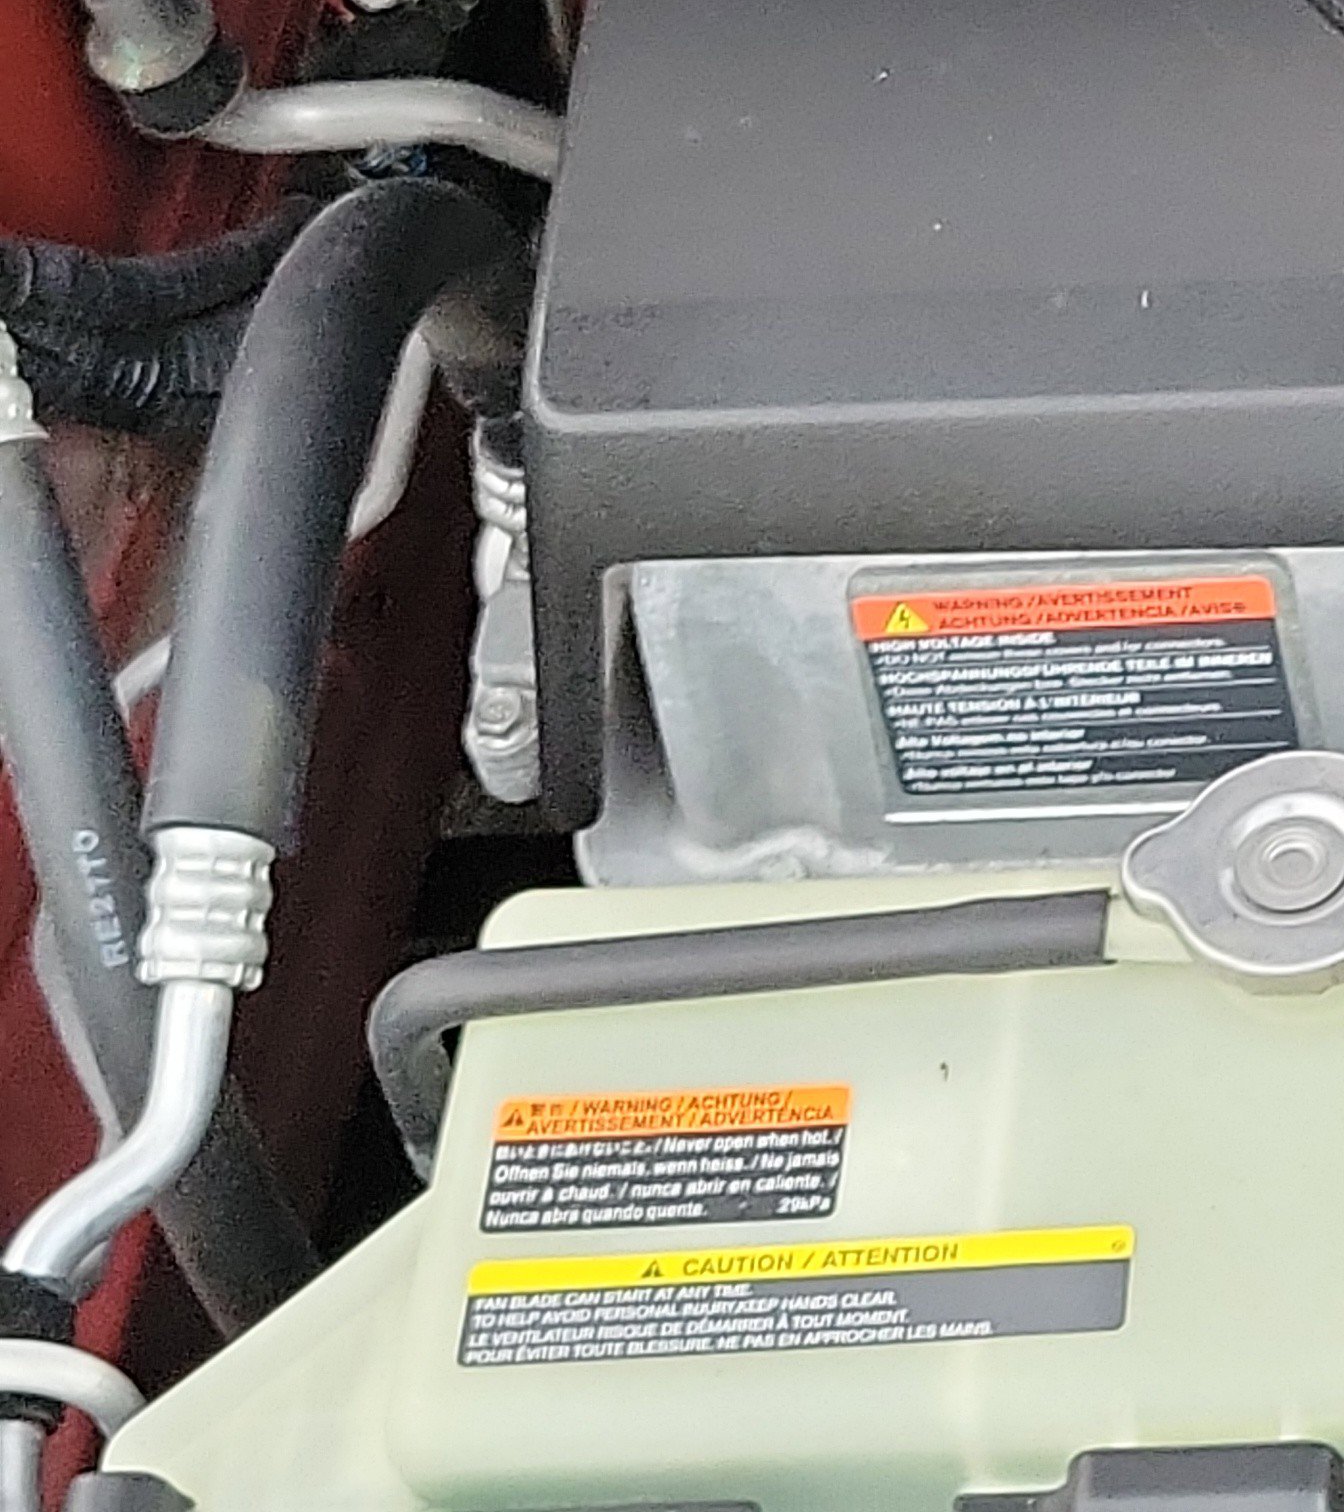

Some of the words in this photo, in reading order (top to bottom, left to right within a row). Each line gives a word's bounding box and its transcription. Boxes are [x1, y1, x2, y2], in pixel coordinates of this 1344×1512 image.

[934, 595, 1022, 611] WARNING
[939, 614, 1031, 629] ACHTUNG
[583, 1097, 672, 1115] WARNING
[688, 1091, 781, 1110] ACHTUNG
[526, 1114, 685, 1136] AVERTISSEMENT
[700, 1105, 834, 1127] ADVERTENCIA
[663, 1135, 712, 1153] Never
[713, 1134, 755, 1153] open
[757, 1131, 800, 1149] when
[552, 1162, 580, 1181] Sie
[653, 1159, 698, 1176] wenn
[785, 1150, 840, 1175] jamais
[489, 1189, 540, 1206] ouvrir
[630, 1180, 682, 1197] nunca
[684, 1176, 728, 1197] abrir
[728, 1179, 751, 1195] en
[485, 1209, 540, 1228] Nunca
[541, 1207, 580, 1226] abra
[582, 1202, 644, 1224] quando
[683, 1252, 793, 1278] CAUTION
[821, 1242, 959, 1268] ATTENTION
[474, 1313, 495, 1328] TO
[498, 1311, 540, 1326] HELP
[541, 1308, 590, 1324] AVOID
[594, 1303, 679, 1322] PERSONAL
[782, 1293, 837, 1310] HANDS
[510, 1294, 562, 1310] BLADE
[564, 1292, 600, 1306] CAN
[603, 1289, 651, 1305] START
[653, 1288, 675, 1303] AT
[677, 1286, 710, 1301] ANY
[464, 1349, 513, 1364] POUR
[573, 1341, 625, 1359] TOUTE
[716, 1335, 740, 1350] NE
[742, 1333, 775, 1349] PAS
[777, 1331, 800, 1347] EN
[802, 1326, 905, 1346] APPROCHER
[907, 1323, 937, 1340] LES
[468, 1332, 491, 1347] LE
[492, 1326, 596, 1345] VENTILATEUR
[661, 1321, 682, 1336] DE
[791, 1312, 833, 1329] TOUT
